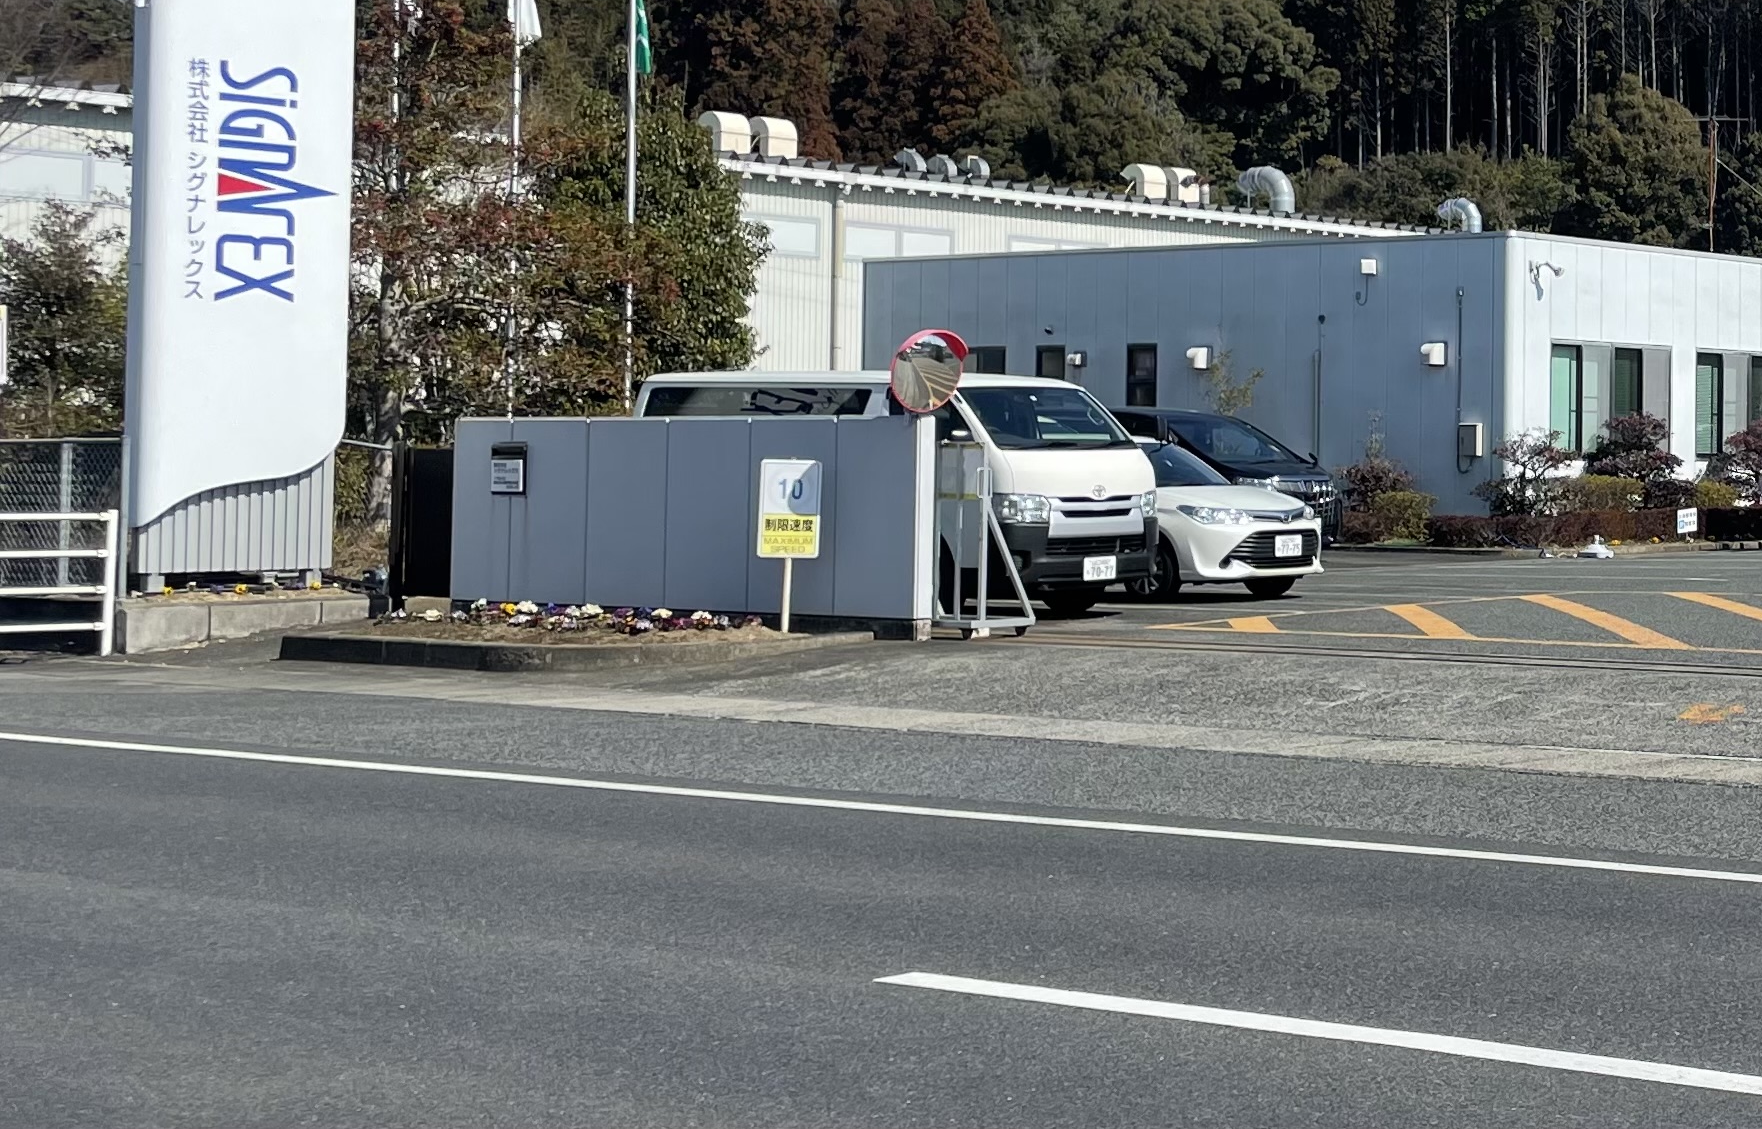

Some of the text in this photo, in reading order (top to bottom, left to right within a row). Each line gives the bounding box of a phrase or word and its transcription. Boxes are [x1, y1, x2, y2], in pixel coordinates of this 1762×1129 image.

[184, 58, 211, 300] 株式会社 シグナレックス
[778, 478, 804, 500] 10
[765, 518, 814, 532] 制限速度
[763, 536, 813, 545] MAXIMUM
[770, 545, 805, 553] SPEED
